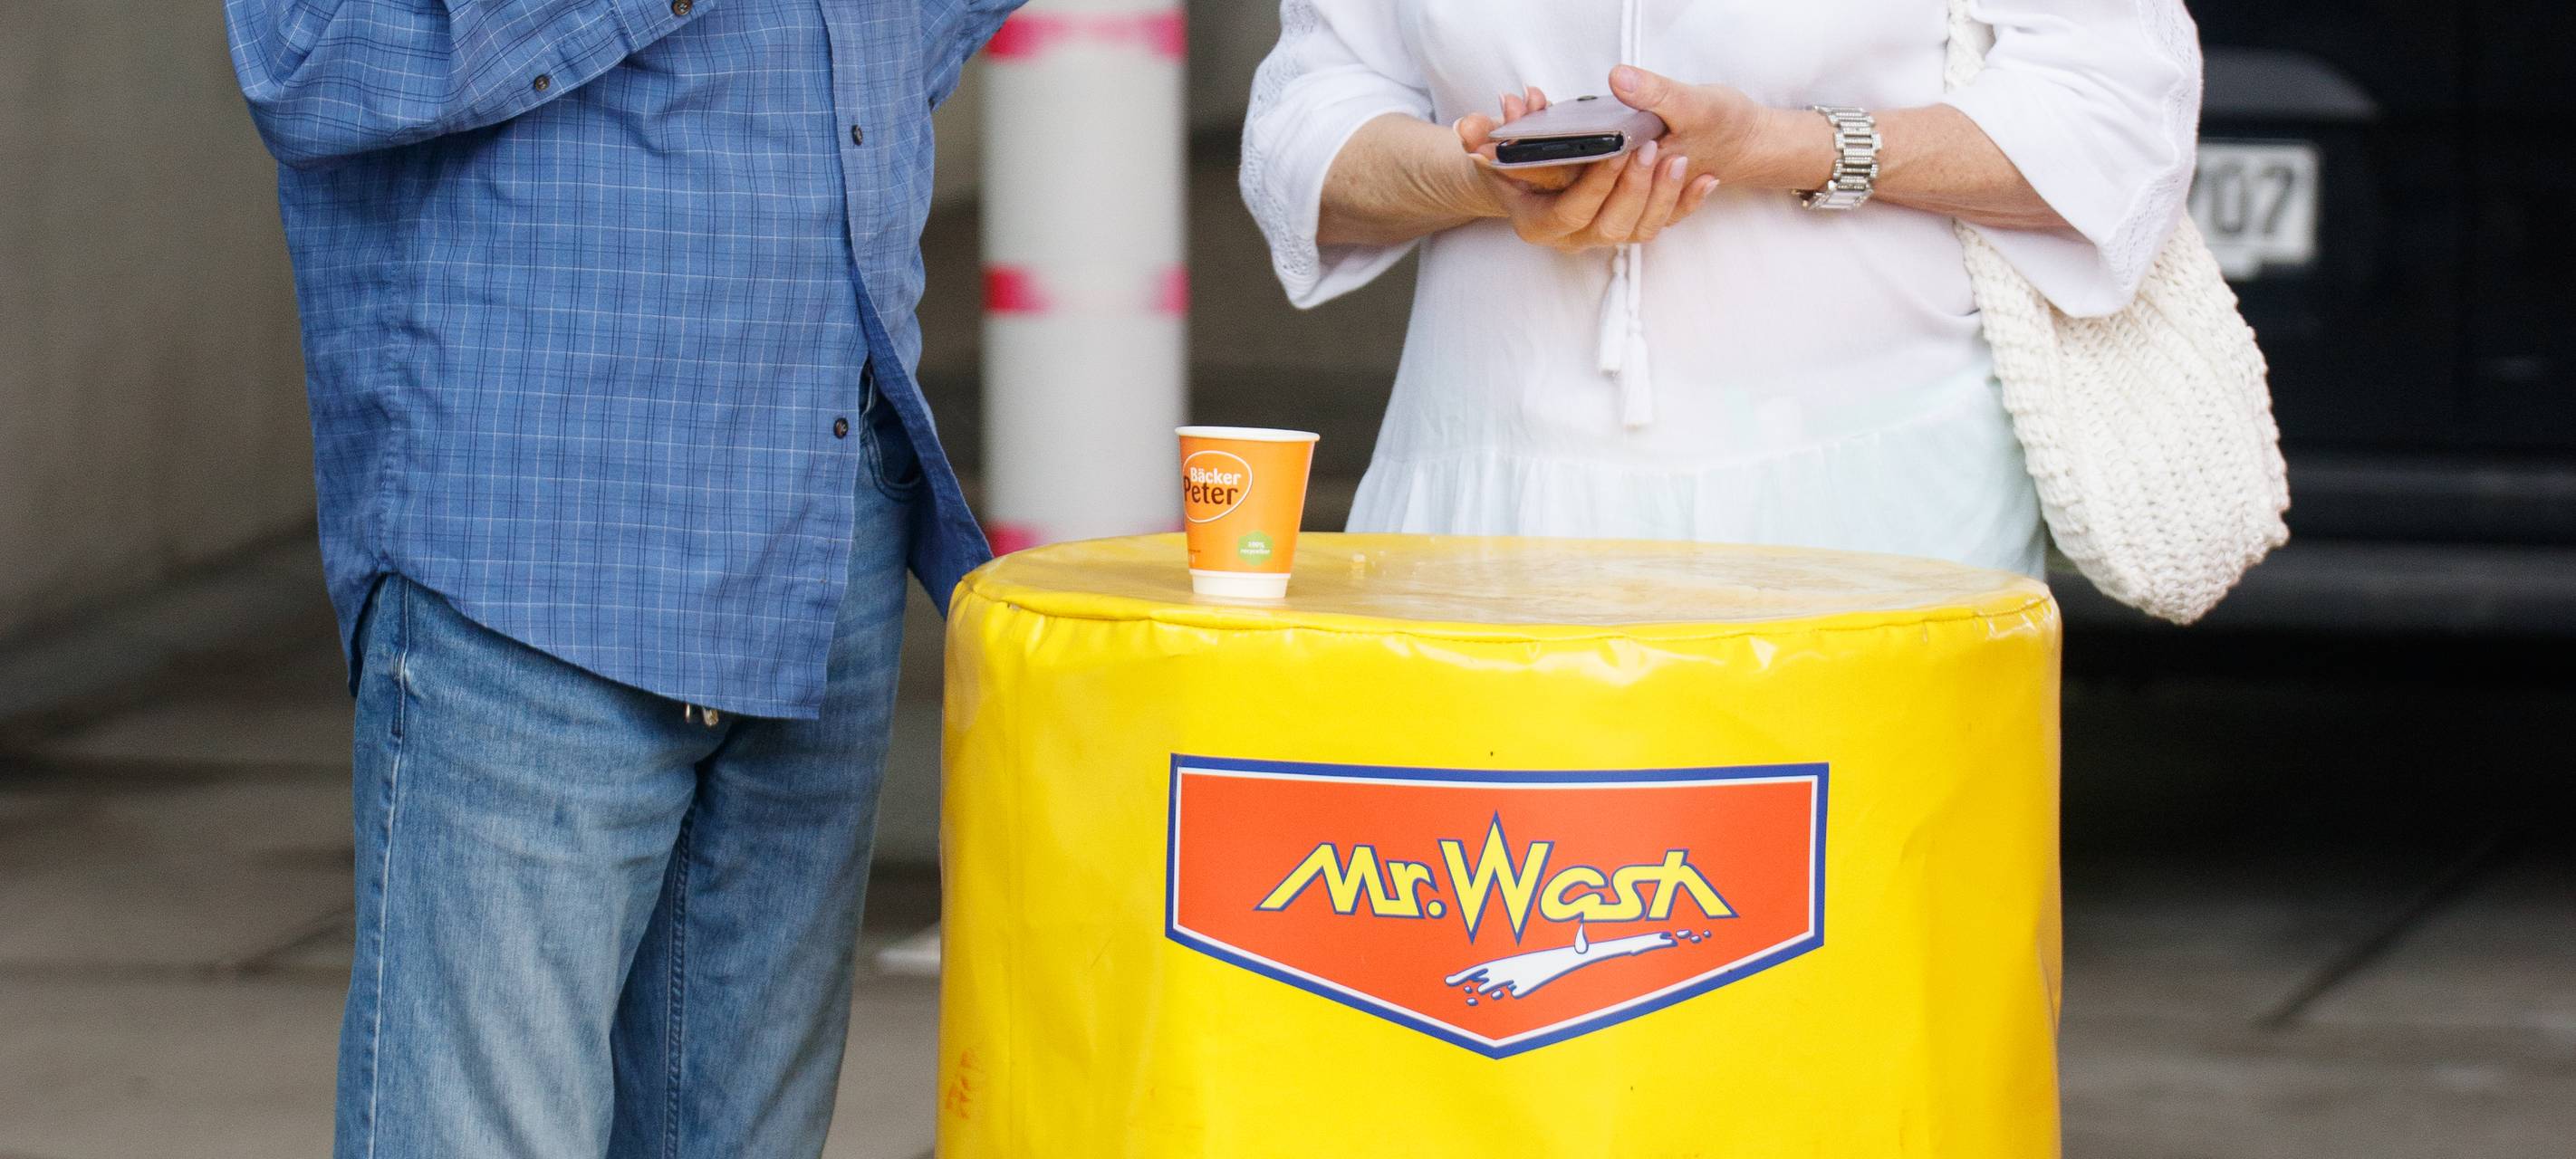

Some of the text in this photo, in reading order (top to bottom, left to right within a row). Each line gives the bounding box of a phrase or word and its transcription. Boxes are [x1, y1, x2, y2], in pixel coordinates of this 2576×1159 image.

[2187, 163, 2295, 237] 07
[1183, 474, 1239, 505] Peter
[1190, 466, 1242, 485] Bäcker
[1254, 809, 1740, 946] Mr. Wash
